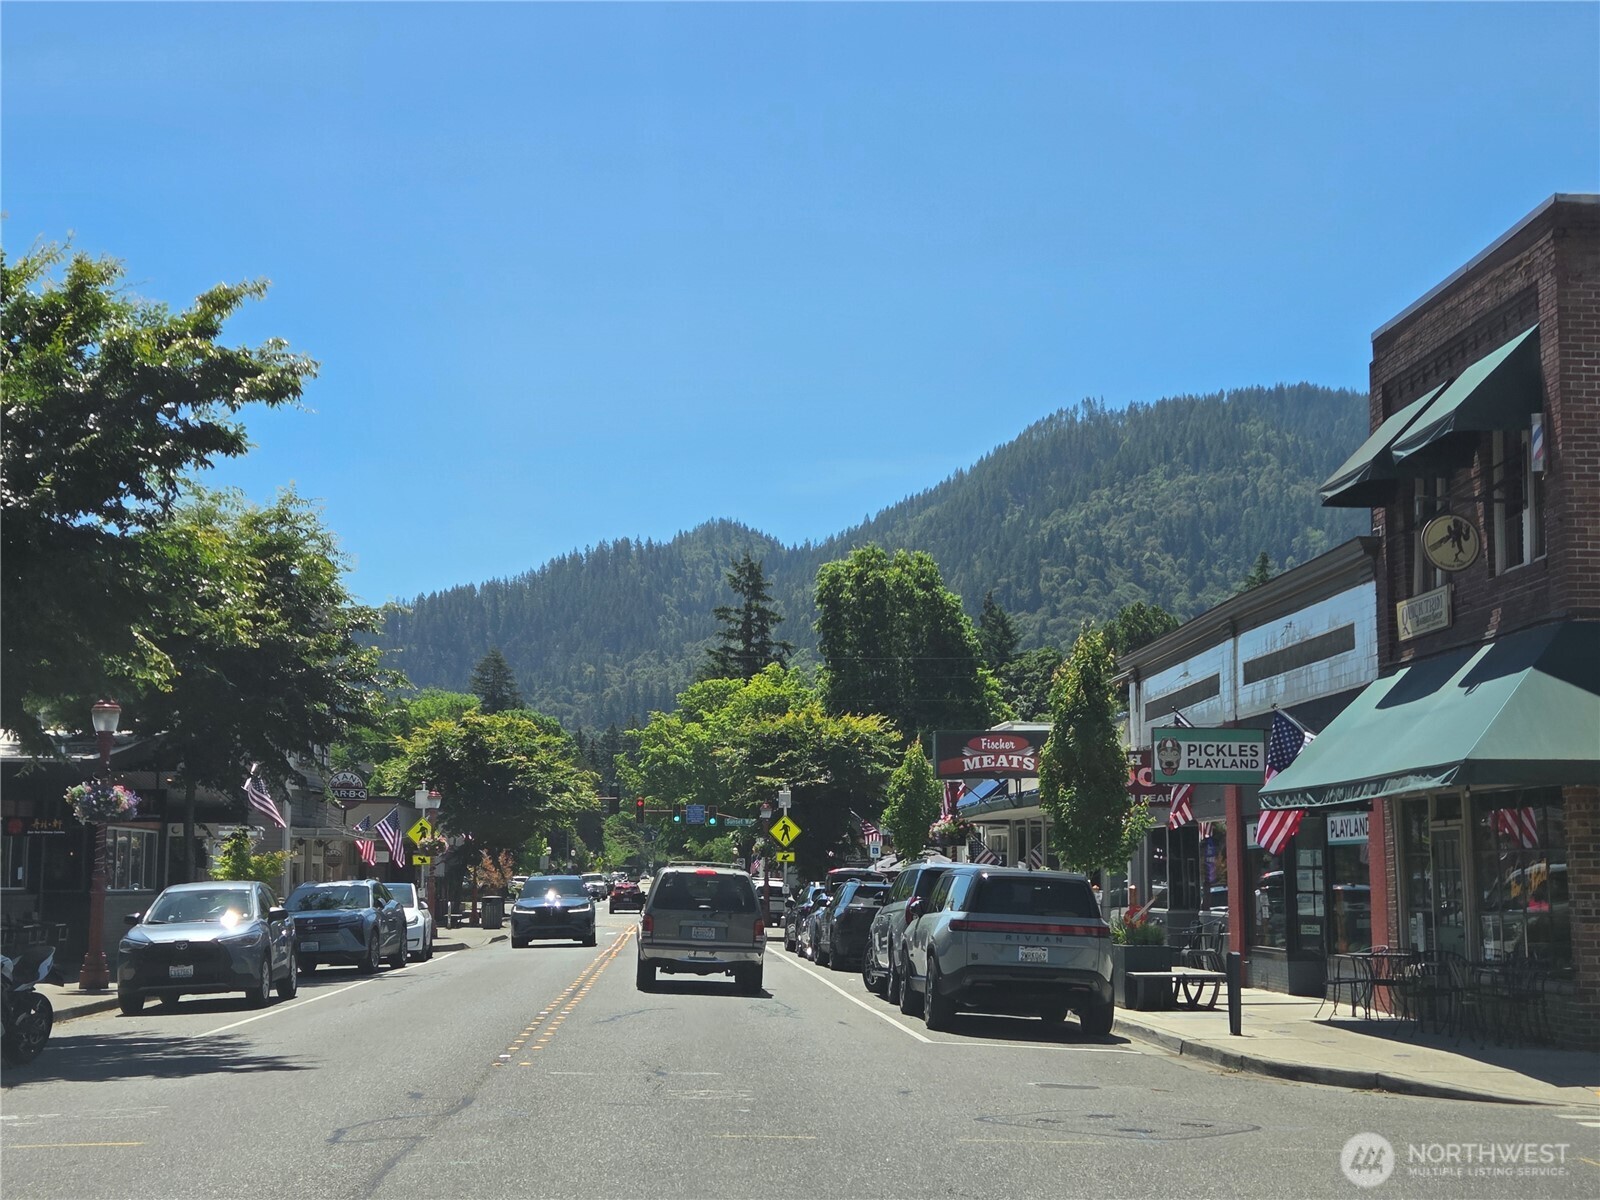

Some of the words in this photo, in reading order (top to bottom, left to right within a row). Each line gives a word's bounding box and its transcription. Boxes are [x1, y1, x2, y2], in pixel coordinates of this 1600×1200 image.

[980, 738, 1016, 750] Fischer
[1187, 743, 1259, 757] PICKLES
[962, 754, 1035, 771] MEATS
[1187, 758, 1259, 769] PLAYLAND
[1005, 934, 1063, 944] RIVIAN
